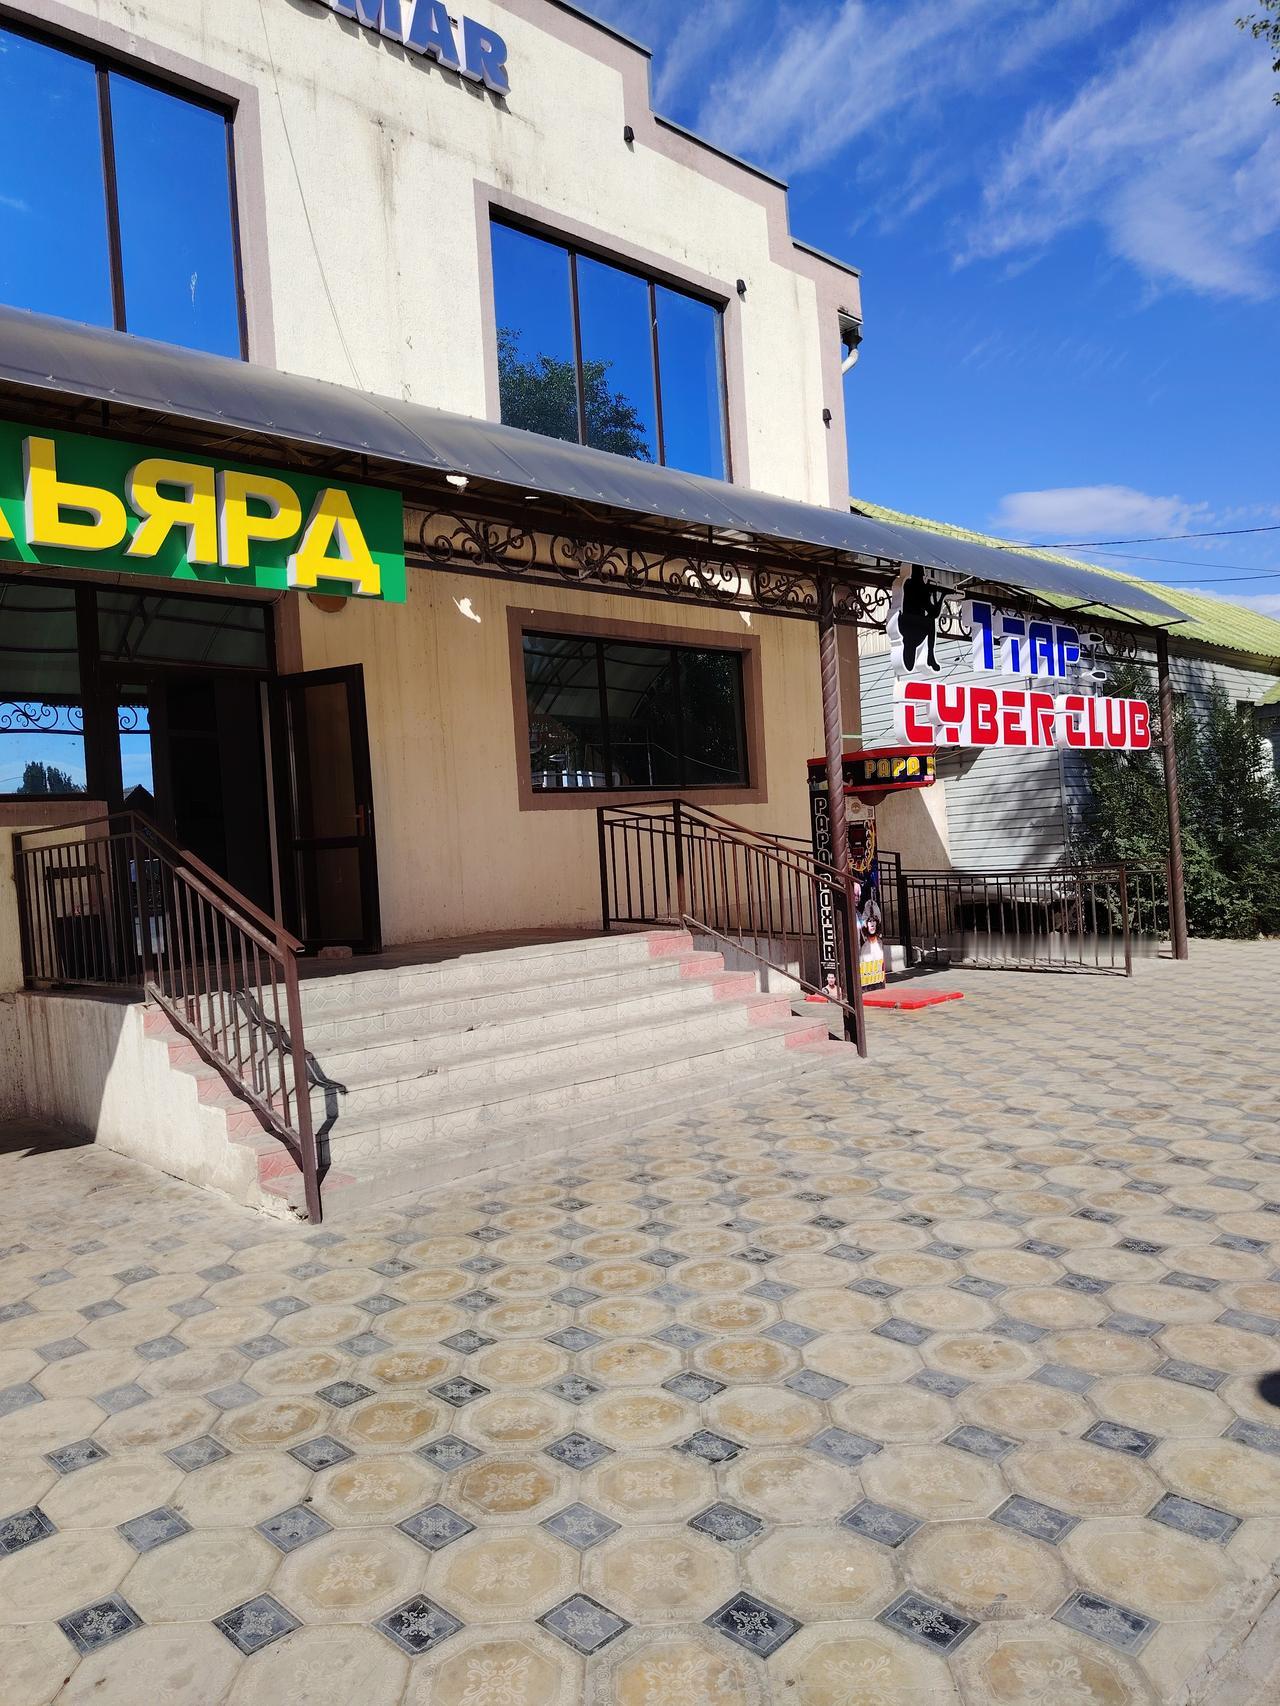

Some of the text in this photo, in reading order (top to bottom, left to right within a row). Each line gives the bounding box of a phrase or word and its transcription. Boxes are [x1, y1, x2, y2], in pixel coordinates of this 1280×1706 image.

[0, 435, 381, 595] ЬЯРД
[903, 681, 1151, 750] CYBER CLUB
